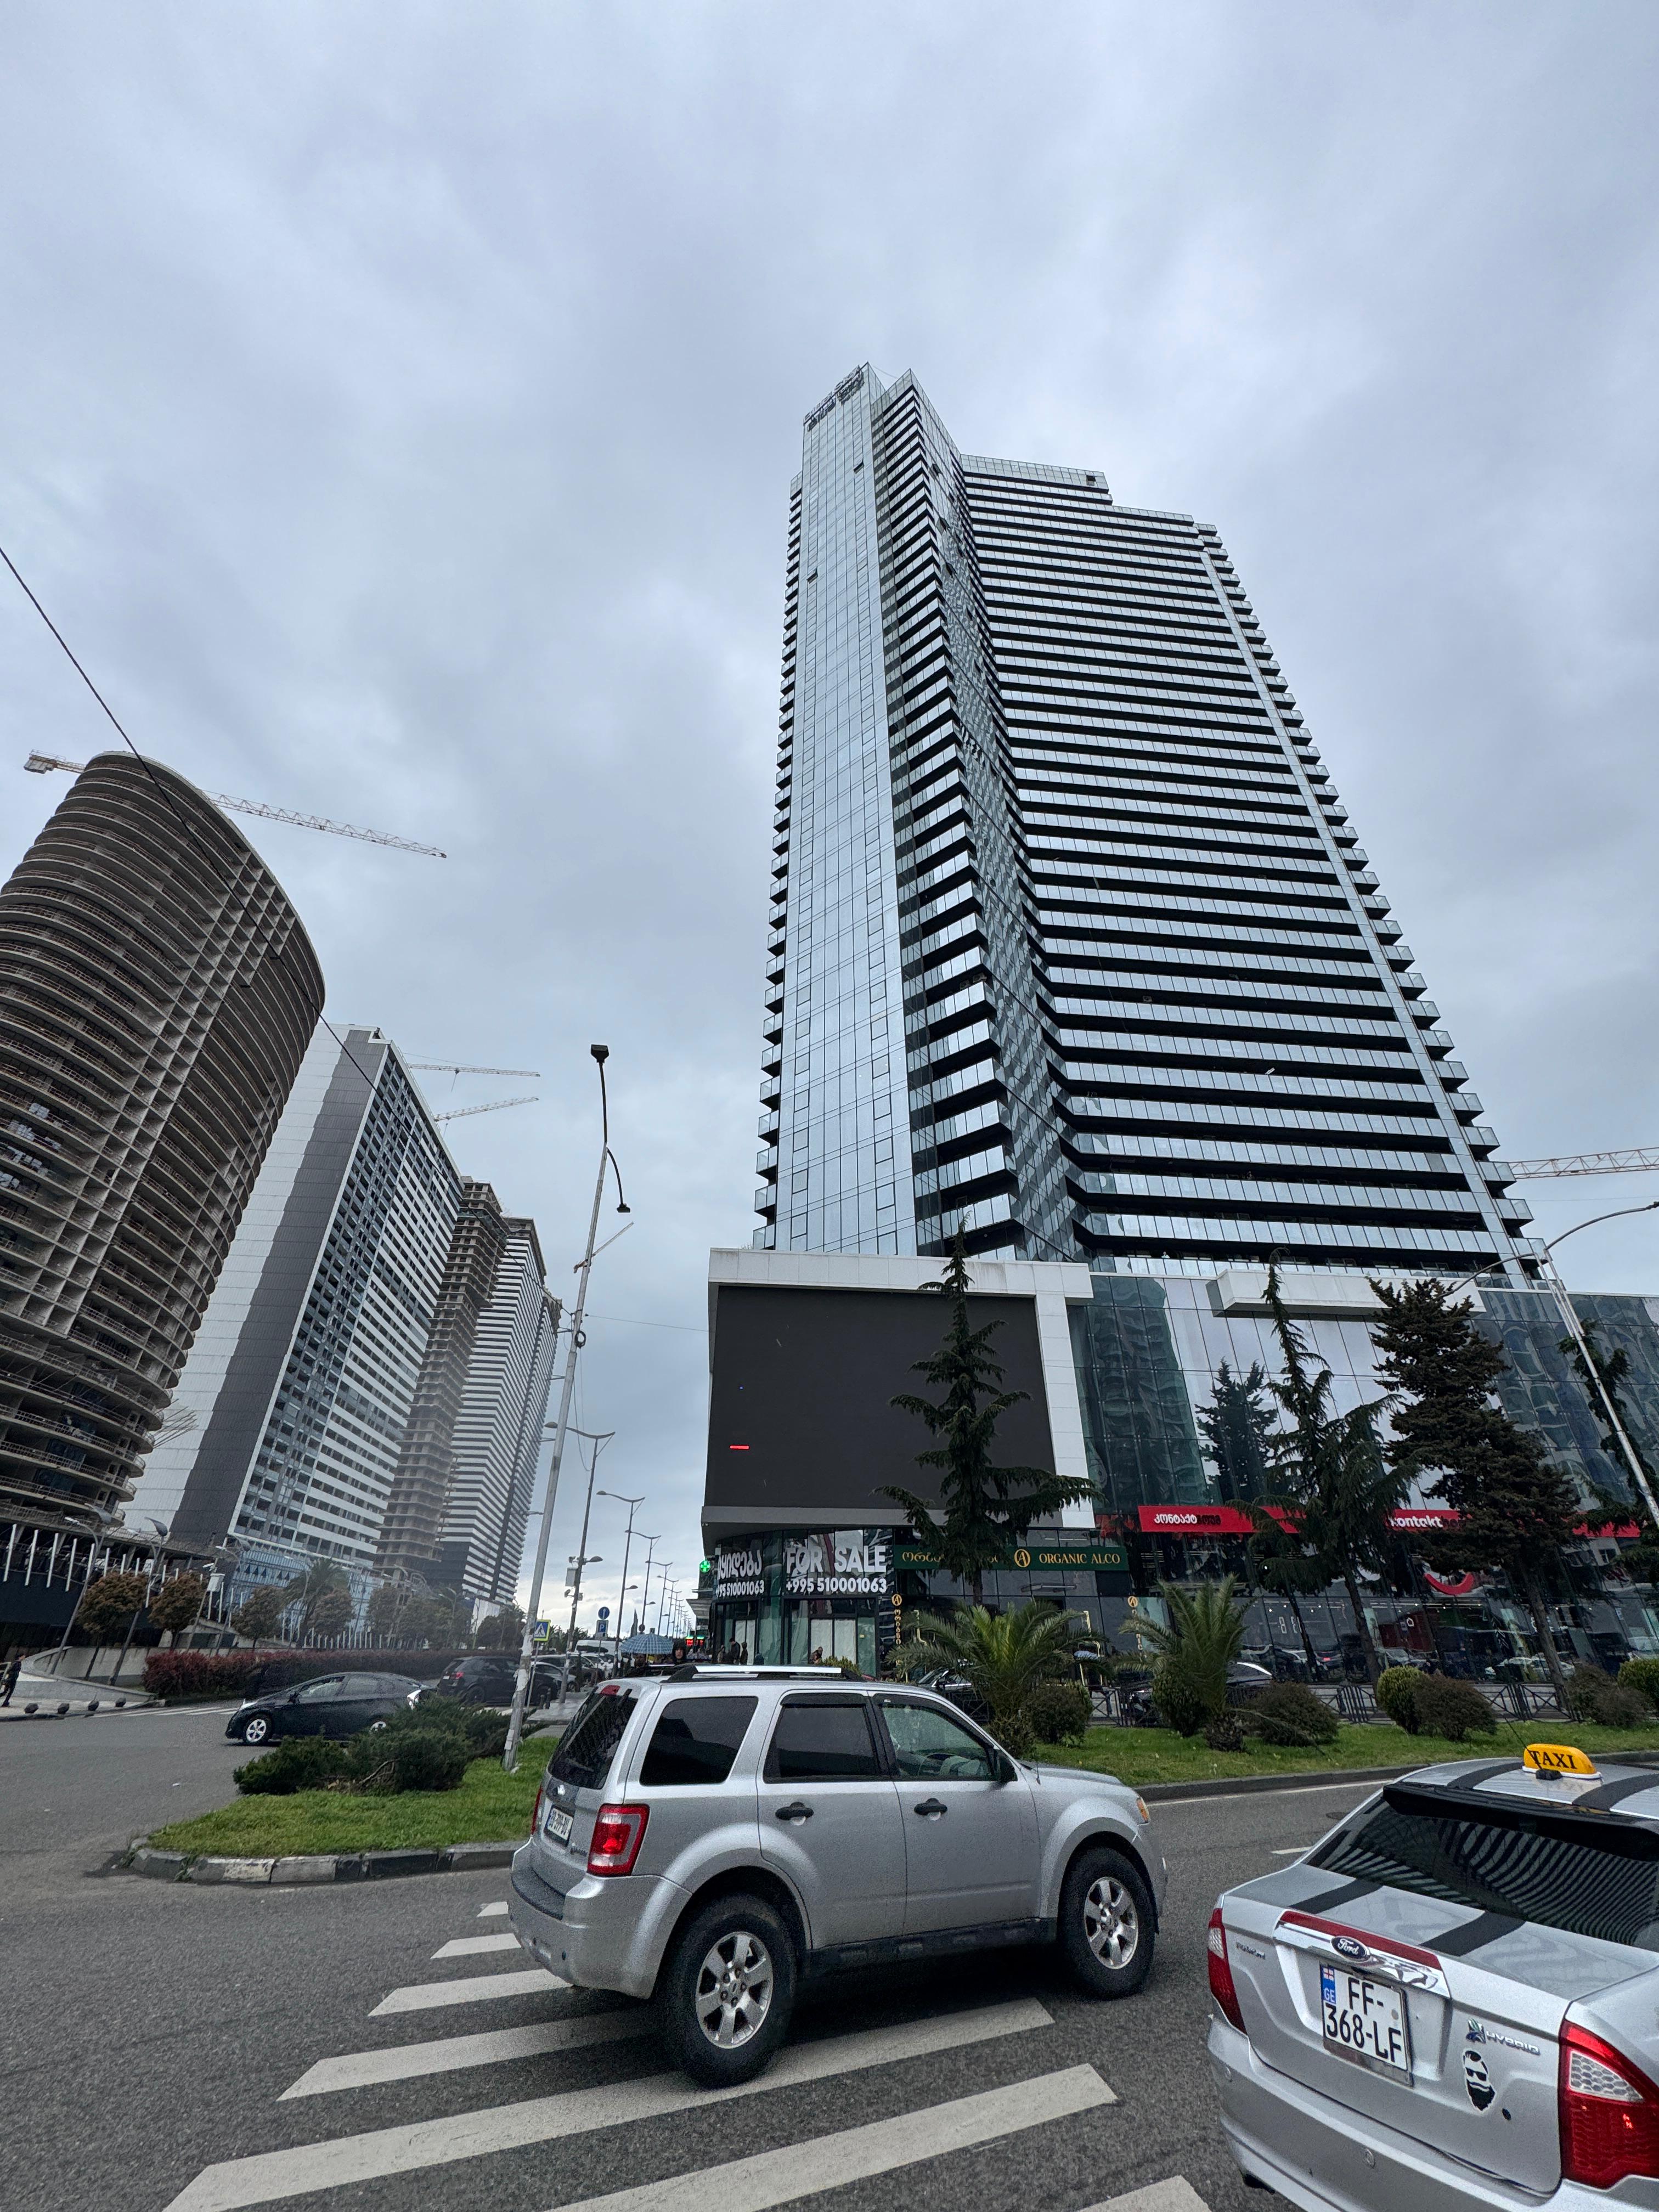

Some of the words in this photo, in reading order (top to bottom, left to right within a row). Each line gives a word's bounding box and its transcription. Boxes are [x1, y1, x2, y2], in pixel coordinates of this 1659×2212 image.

[787, 1547, 823, 1573] FOR
[834, 1545, 887, 1572] SALE
[1039, 1553, 1087, 1564] ORGANIC
[1091, 1554, 1120, 1564] ALCO
[786, 1578, 814, 1593] +995
[817, 1577, 887, 1593] 510001063
[1528, 1750, 1577, 1769] TAXI
[1337, 1938, 1359, 1955] Ford
[1324, 1987, 1335, 2003] GE
[1325, 2002, 1401, 2063] 368-LF
[1486, 2031, 1541, 2056] HYBRID
